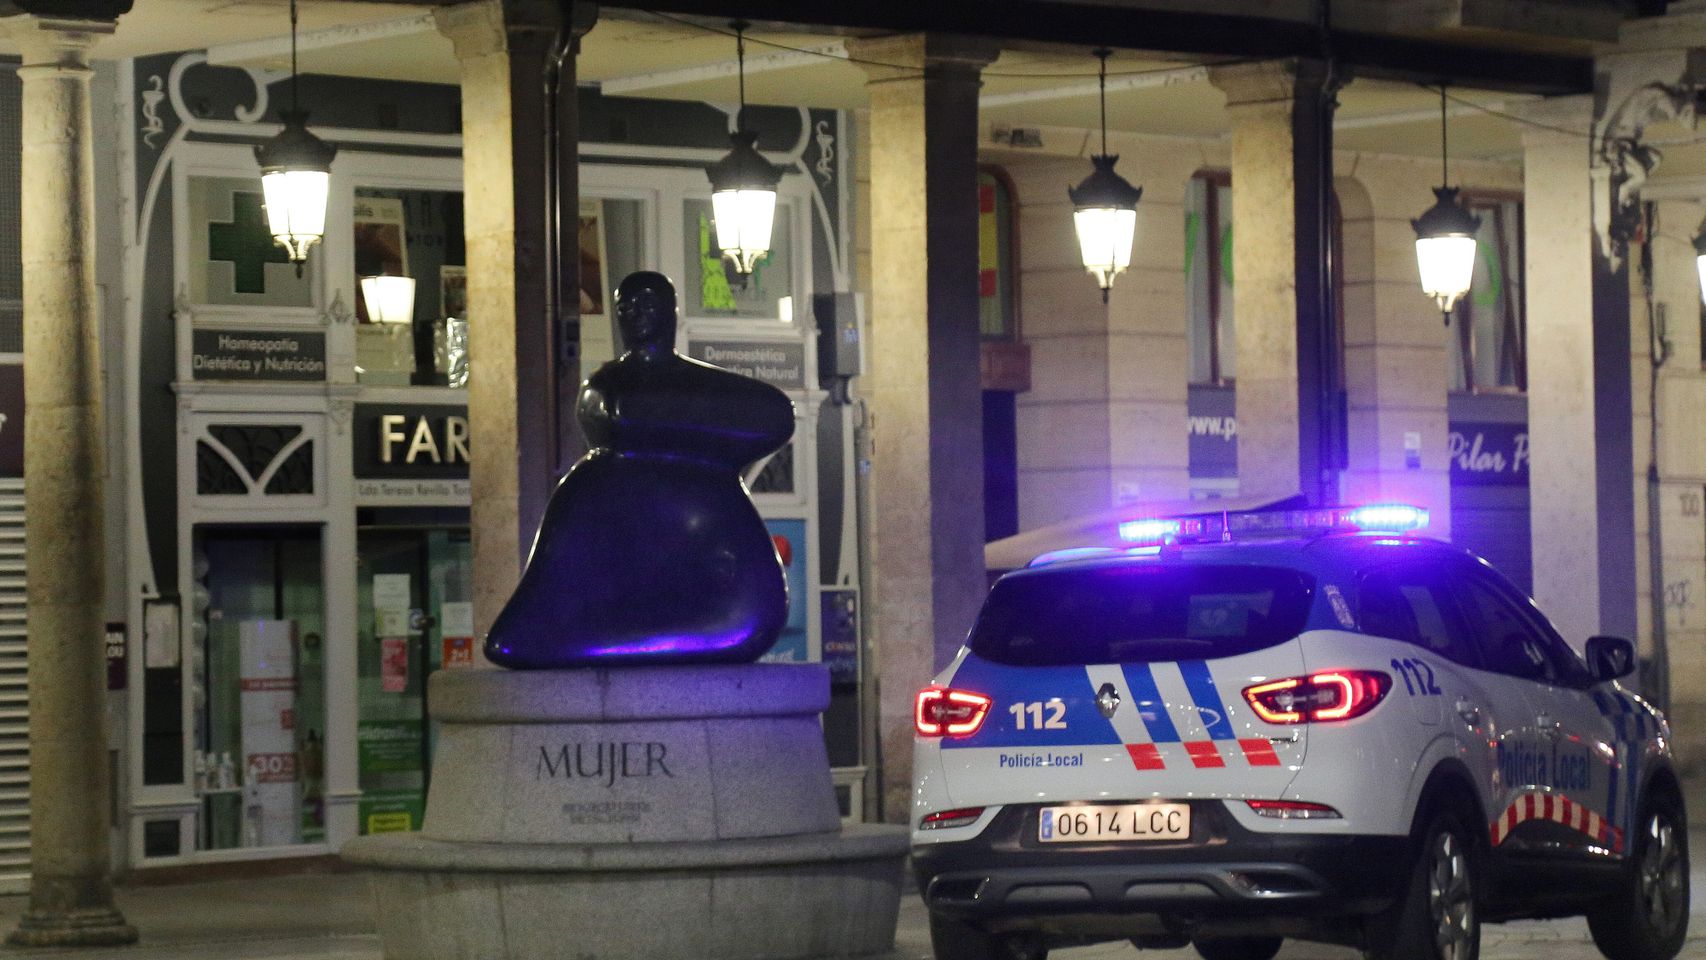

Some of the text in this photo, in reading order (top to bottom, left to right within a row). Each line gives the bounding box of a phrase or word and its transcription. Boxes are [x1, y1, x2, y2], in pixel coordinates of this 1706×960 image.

[252, 360, 262, 374] y
[755, 365, 799, 381] Natural
[382, 414, 470, 463] FAR
[1448, 431, 1530, 473] Pilar P
[1390, 657, 1442, 697] 112
[1009, 700, 1067, 730] 112
[537, 742, 675, 788] MUJER
[1000, 753, 1083, 768] Policía Local
[1552, 742, 1591, 791] Local
[1058, 810, 1181, 836] 0614 LCC
